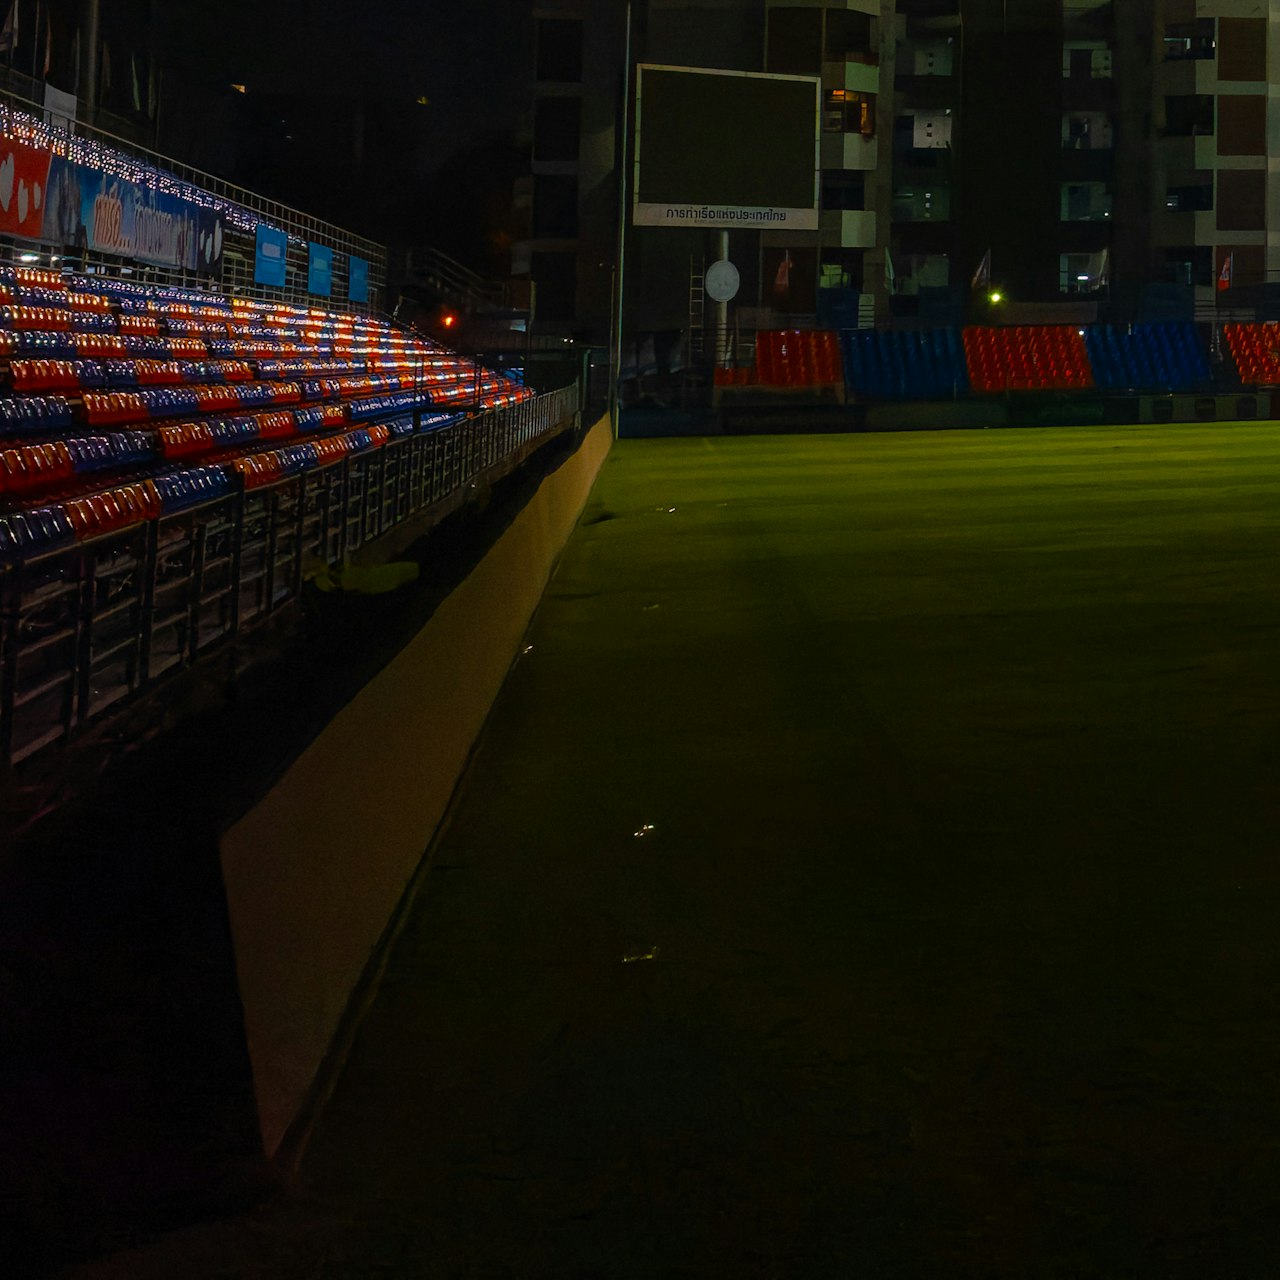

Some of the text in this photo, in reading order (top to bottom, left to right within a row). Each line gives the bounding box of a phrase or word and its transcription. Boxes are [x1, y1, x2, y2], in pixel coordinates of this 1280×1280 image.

[666, 207, 787, 221] การท่าเรือแห่งประเทศไทย
